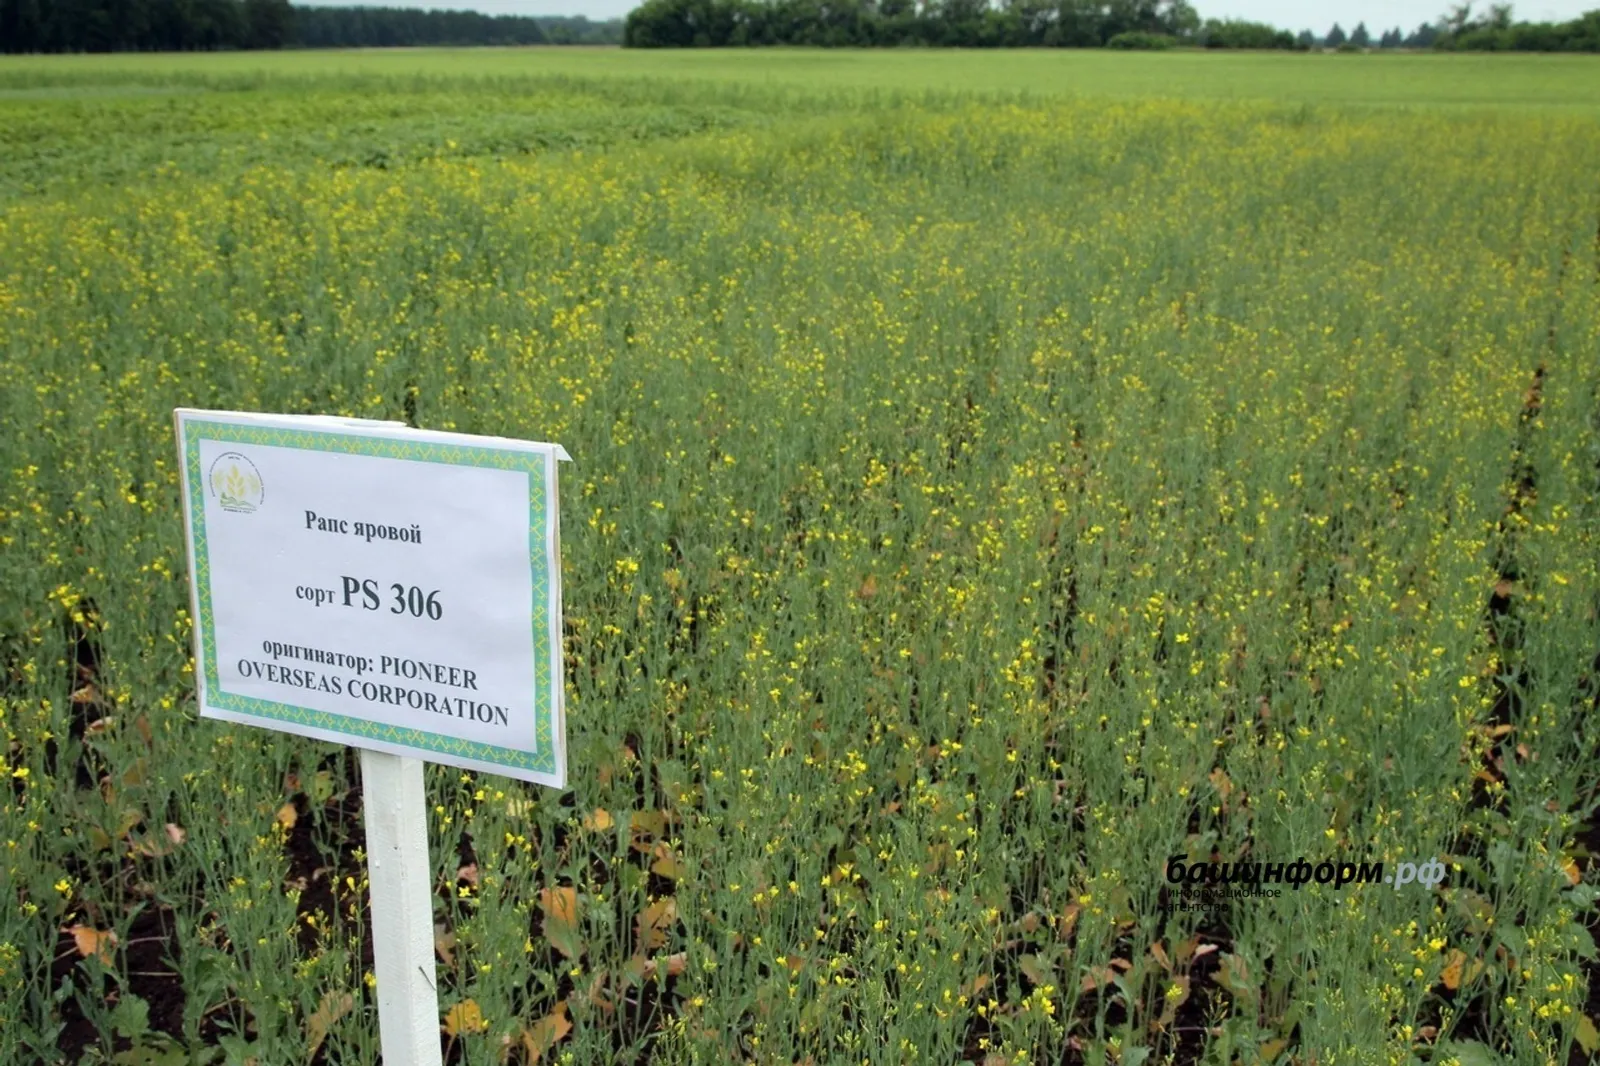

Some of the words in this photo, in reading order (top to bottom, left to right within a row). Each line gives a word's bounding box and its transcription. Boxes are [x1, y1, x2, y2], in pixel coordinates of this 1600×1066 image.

[304, 510, 349, 536] Рапс
[353, 522, 423, 545] яровой
[295, 585, 336, 608] сорт
[340, 575, 381, 612] PS
[390, 583, 443, 622] 306
[262, 640, 374, 676] оригинатор:
[380, 655, 479, 692] PIONEER
[237, 659, 343, 696] OVERSEAS
[347, 679, 510, 727] CORPORATION
